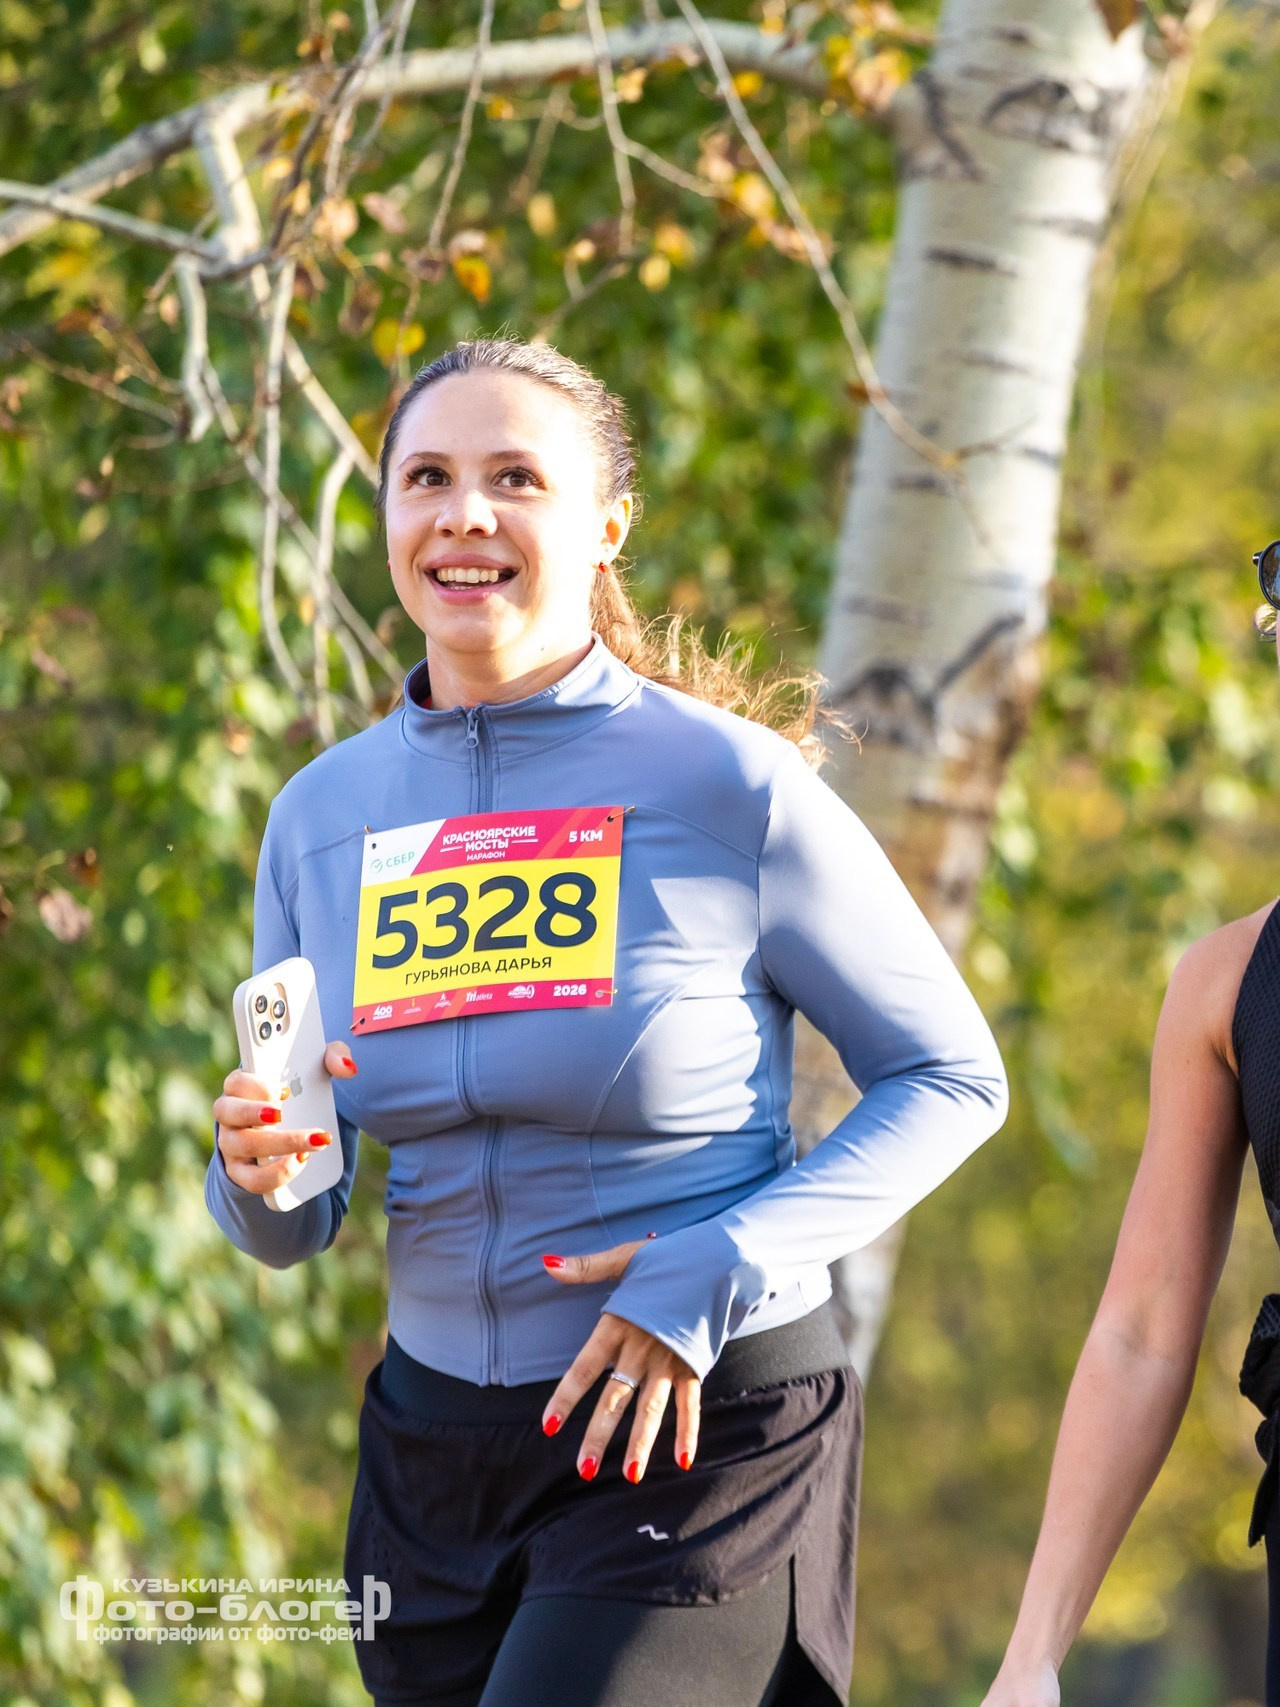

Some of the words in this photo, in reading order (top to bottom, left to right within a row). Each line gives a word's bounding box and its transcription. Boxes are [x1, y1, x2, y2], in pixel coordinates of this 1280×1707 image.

[442, 825, 536, 846] КРАСНОЯРСКИЕ
[568, 831, 578, 843] 5
[580, 829, 603, 842] КМ
[465, 838, 509, 853] МОСТЫ
[385, 851, 416, 869] СБЕР
[466, 851, 506, 862] МАРАФОН
[371, 871, 598, 970] 5328
[405, 960, 491, 986] ГУРЬЯНОВА
[495, 956, 552, 974] ДАРЬЯ
[553, 984, 588, 997] 2026
